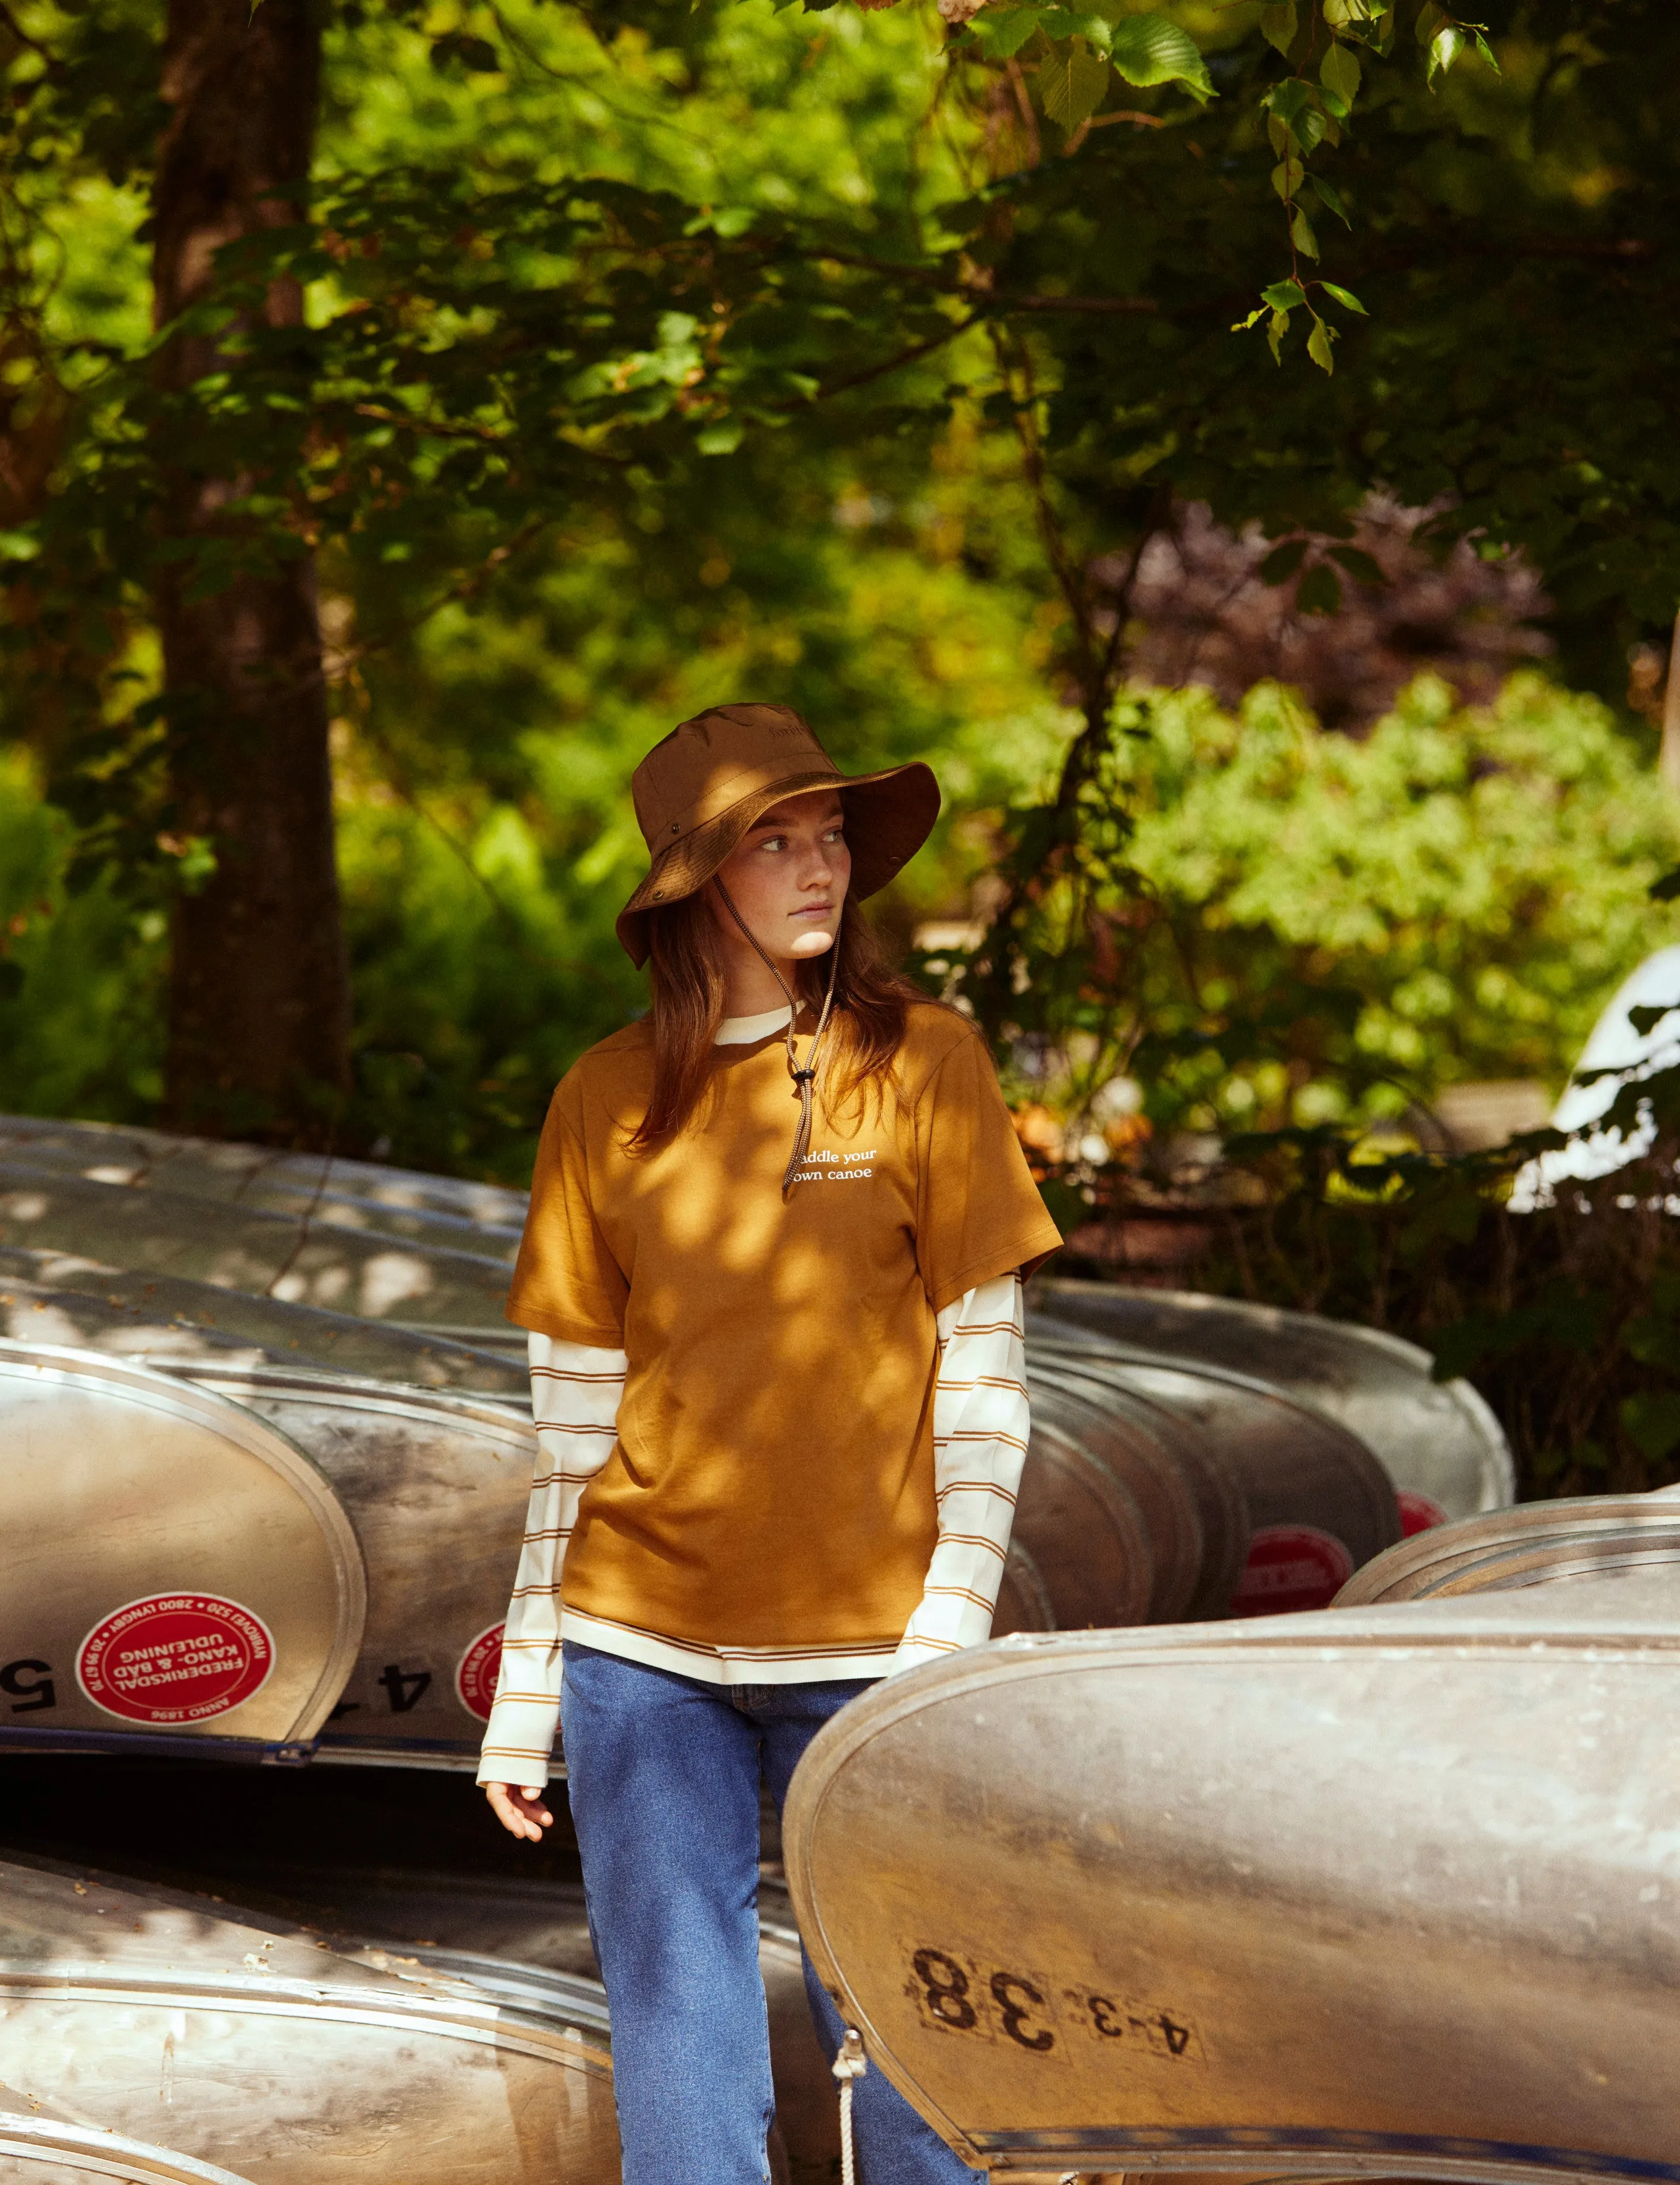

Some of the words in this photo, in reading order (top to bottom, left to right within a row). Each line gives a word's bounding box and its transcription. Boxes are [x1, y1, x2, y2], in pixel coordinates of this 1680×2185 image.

[801, 1150, 839, 1164] addle
[843, 1150, 877, 1165] your
[793, 1171, 823, 1182] own
[828, 1168, 872, 1180] canoe
[158, 1599, 194, 1611] 2800
[206, 1603, 233, 1618] 520
[109, 1603, 156, 1633] LYNGBY
[230, 1613, 267, 1659] NYBROVEJ
[119, 1633, 224, 1663] UDLEJNING
[177, 1644, 239, 1665] KANO-
[113, 1661, 154, 1678] BÅD
[114, 1657, 245, 1691] FREDERIKSDAL
[156, 1657, 173, 1670] &
[0, 1659, 56, 1714] 5
[150, 1710, 185, 1720] 1896
[188, 1697, 230, 1718] ANNO
[913, 1948, 1054, 2051] 38
